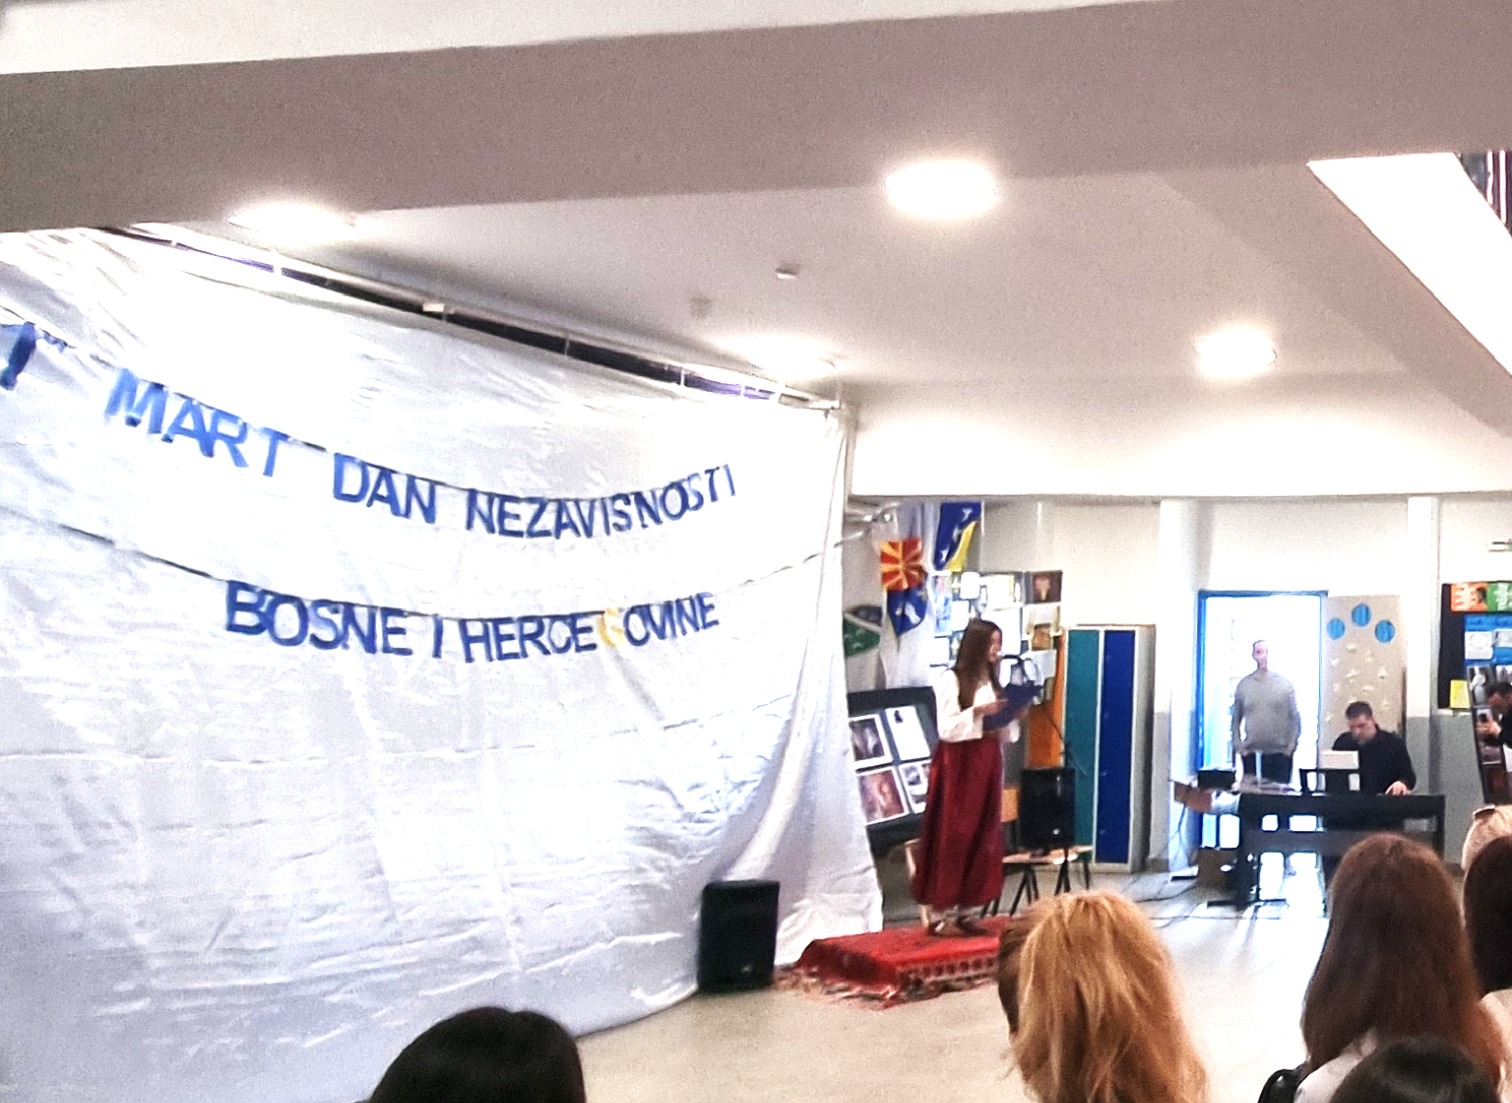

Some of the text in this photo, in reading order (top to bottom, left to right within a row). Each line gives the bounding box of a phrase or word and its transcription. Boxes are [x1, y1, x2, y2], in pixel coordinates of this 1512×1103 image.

[103, 367, 290, 478] MART
[333, 452, 437, 525] DAN
[464, 463, 736, 541] NEZAVISNOSTI
[225, 579, 413, 656] BOSNE
[432, 613, 443, 659] I
